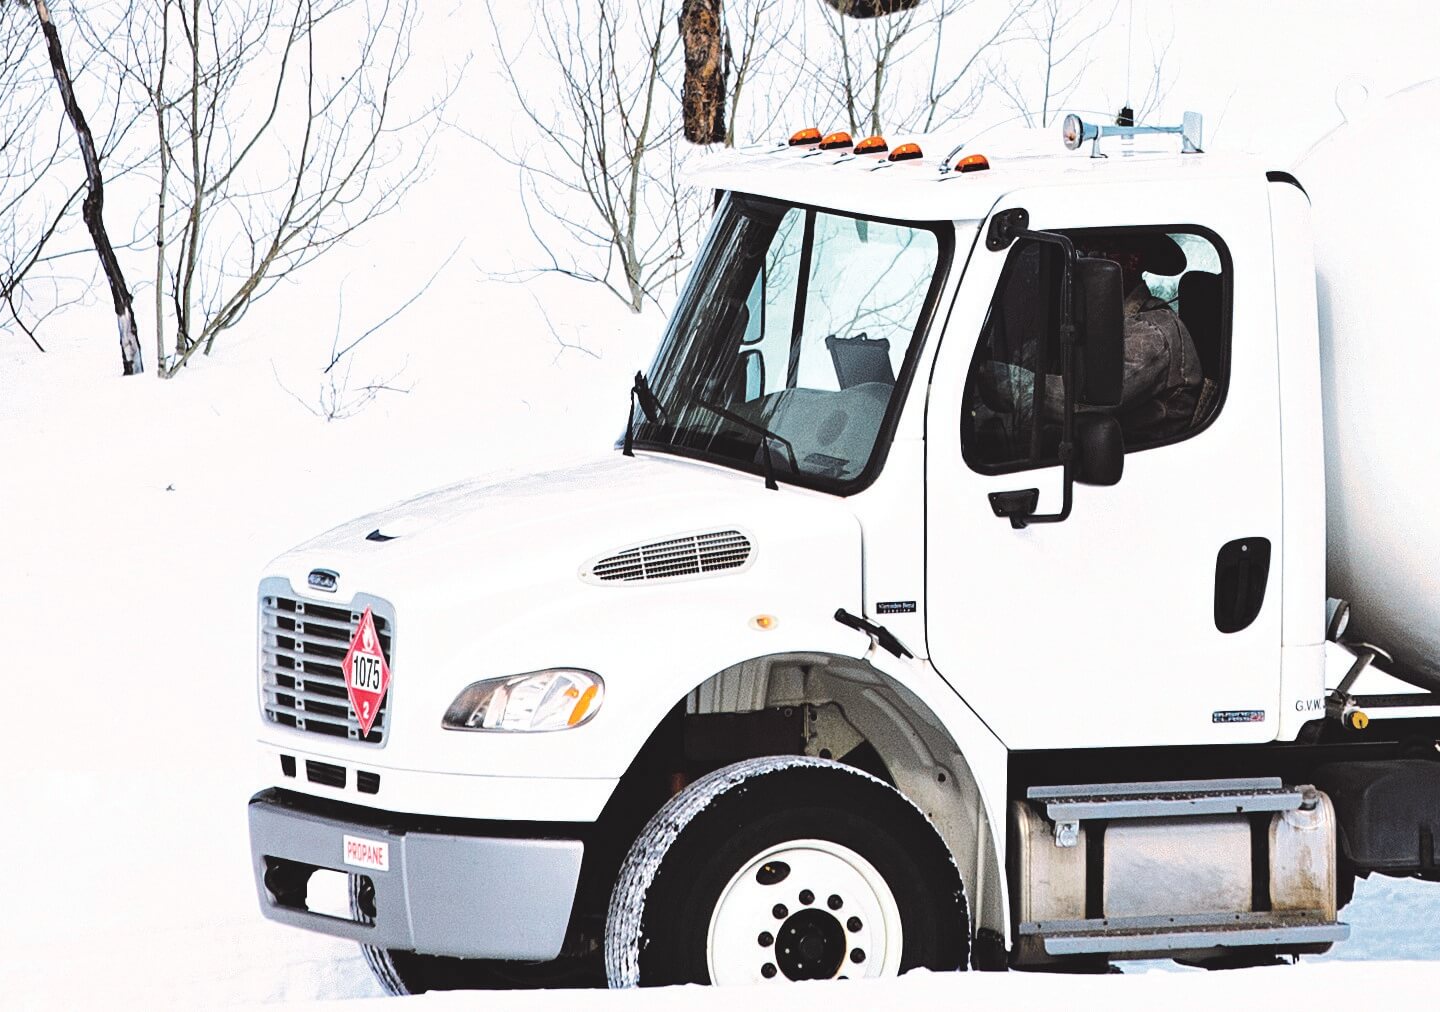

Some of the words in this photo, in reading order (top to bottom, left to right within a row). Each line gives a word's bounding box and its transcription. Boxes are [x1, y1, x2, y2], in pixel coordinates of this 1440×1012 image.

[353, 655, 380, 690] 1075
[363, 701, 370, 719] 2
[347, 841, 383, 866] PROPANE
